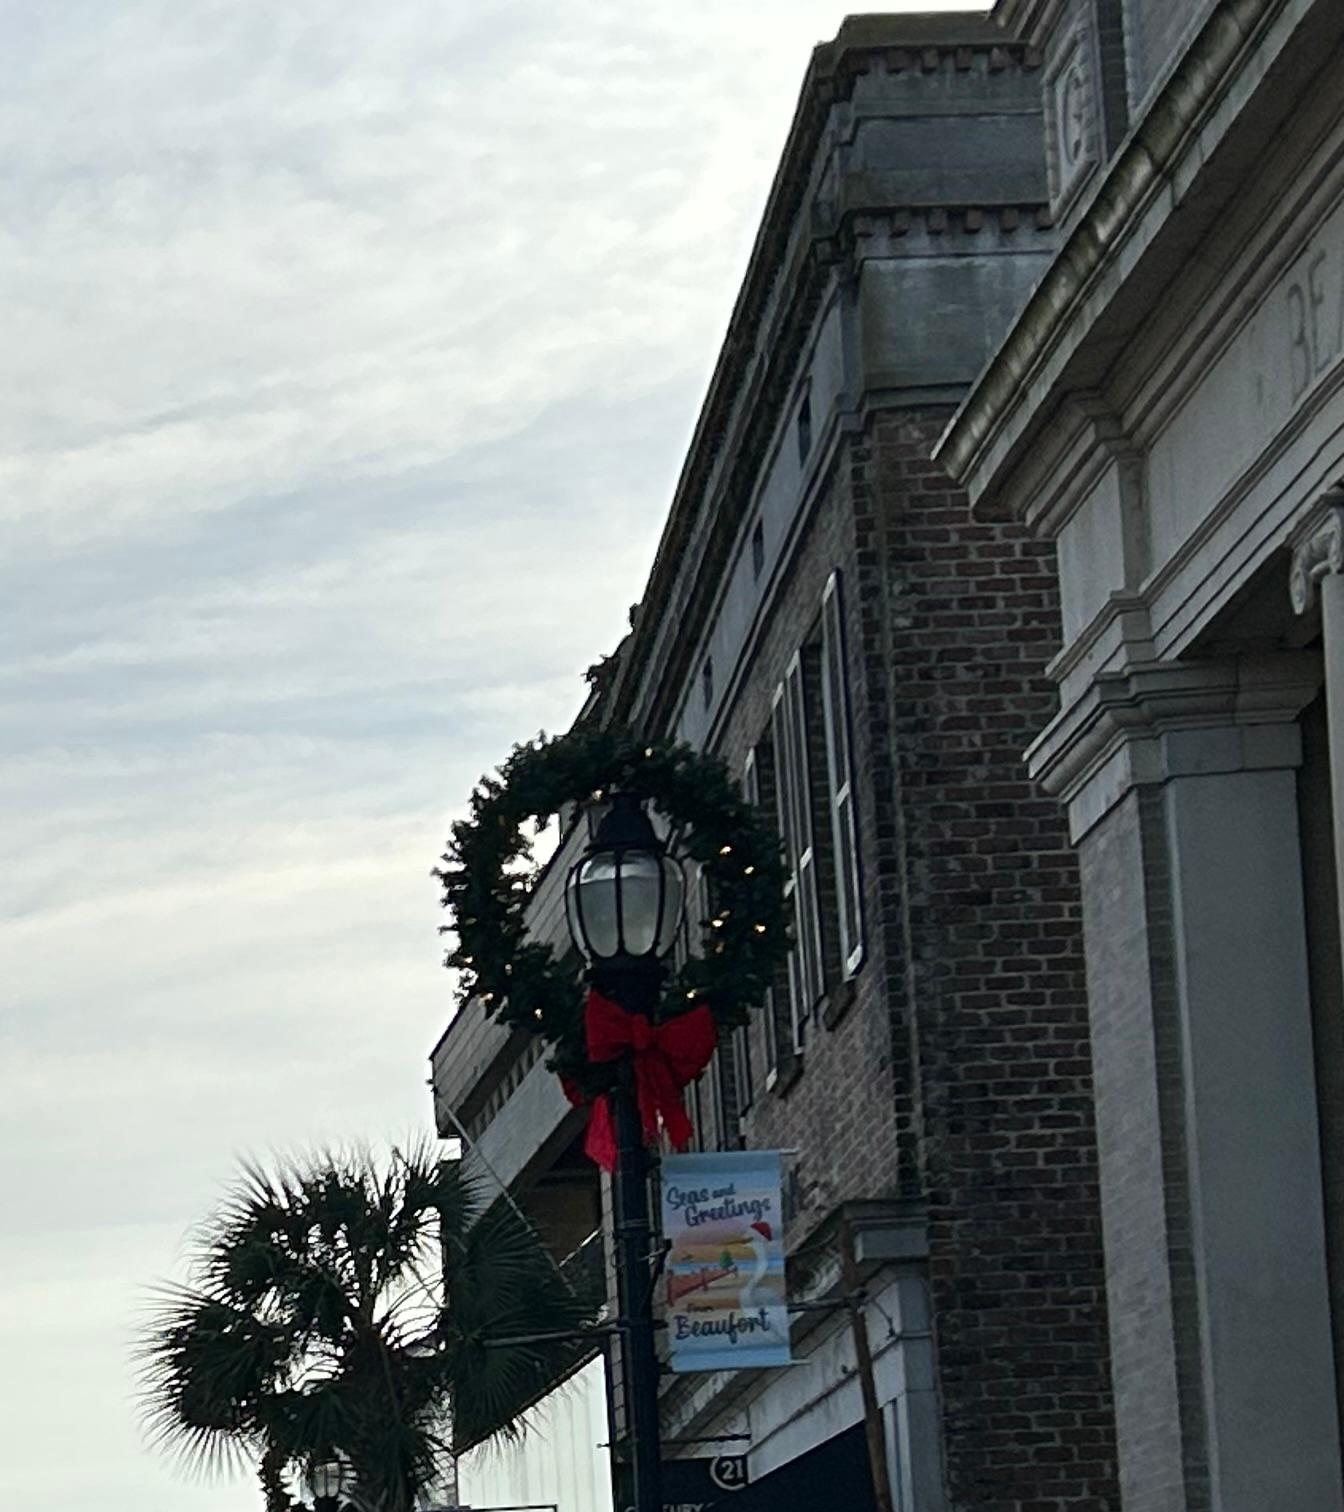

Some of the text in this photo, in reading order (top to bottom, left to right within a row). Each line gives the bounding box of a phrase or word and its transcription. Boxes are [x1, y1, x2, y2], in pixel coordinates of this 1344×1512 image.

[667, 1183, 736, 1210] Seas and
[685, 1198, 771, 1227] Greetings
[674, 1308, 770, 1344] Beaufort
